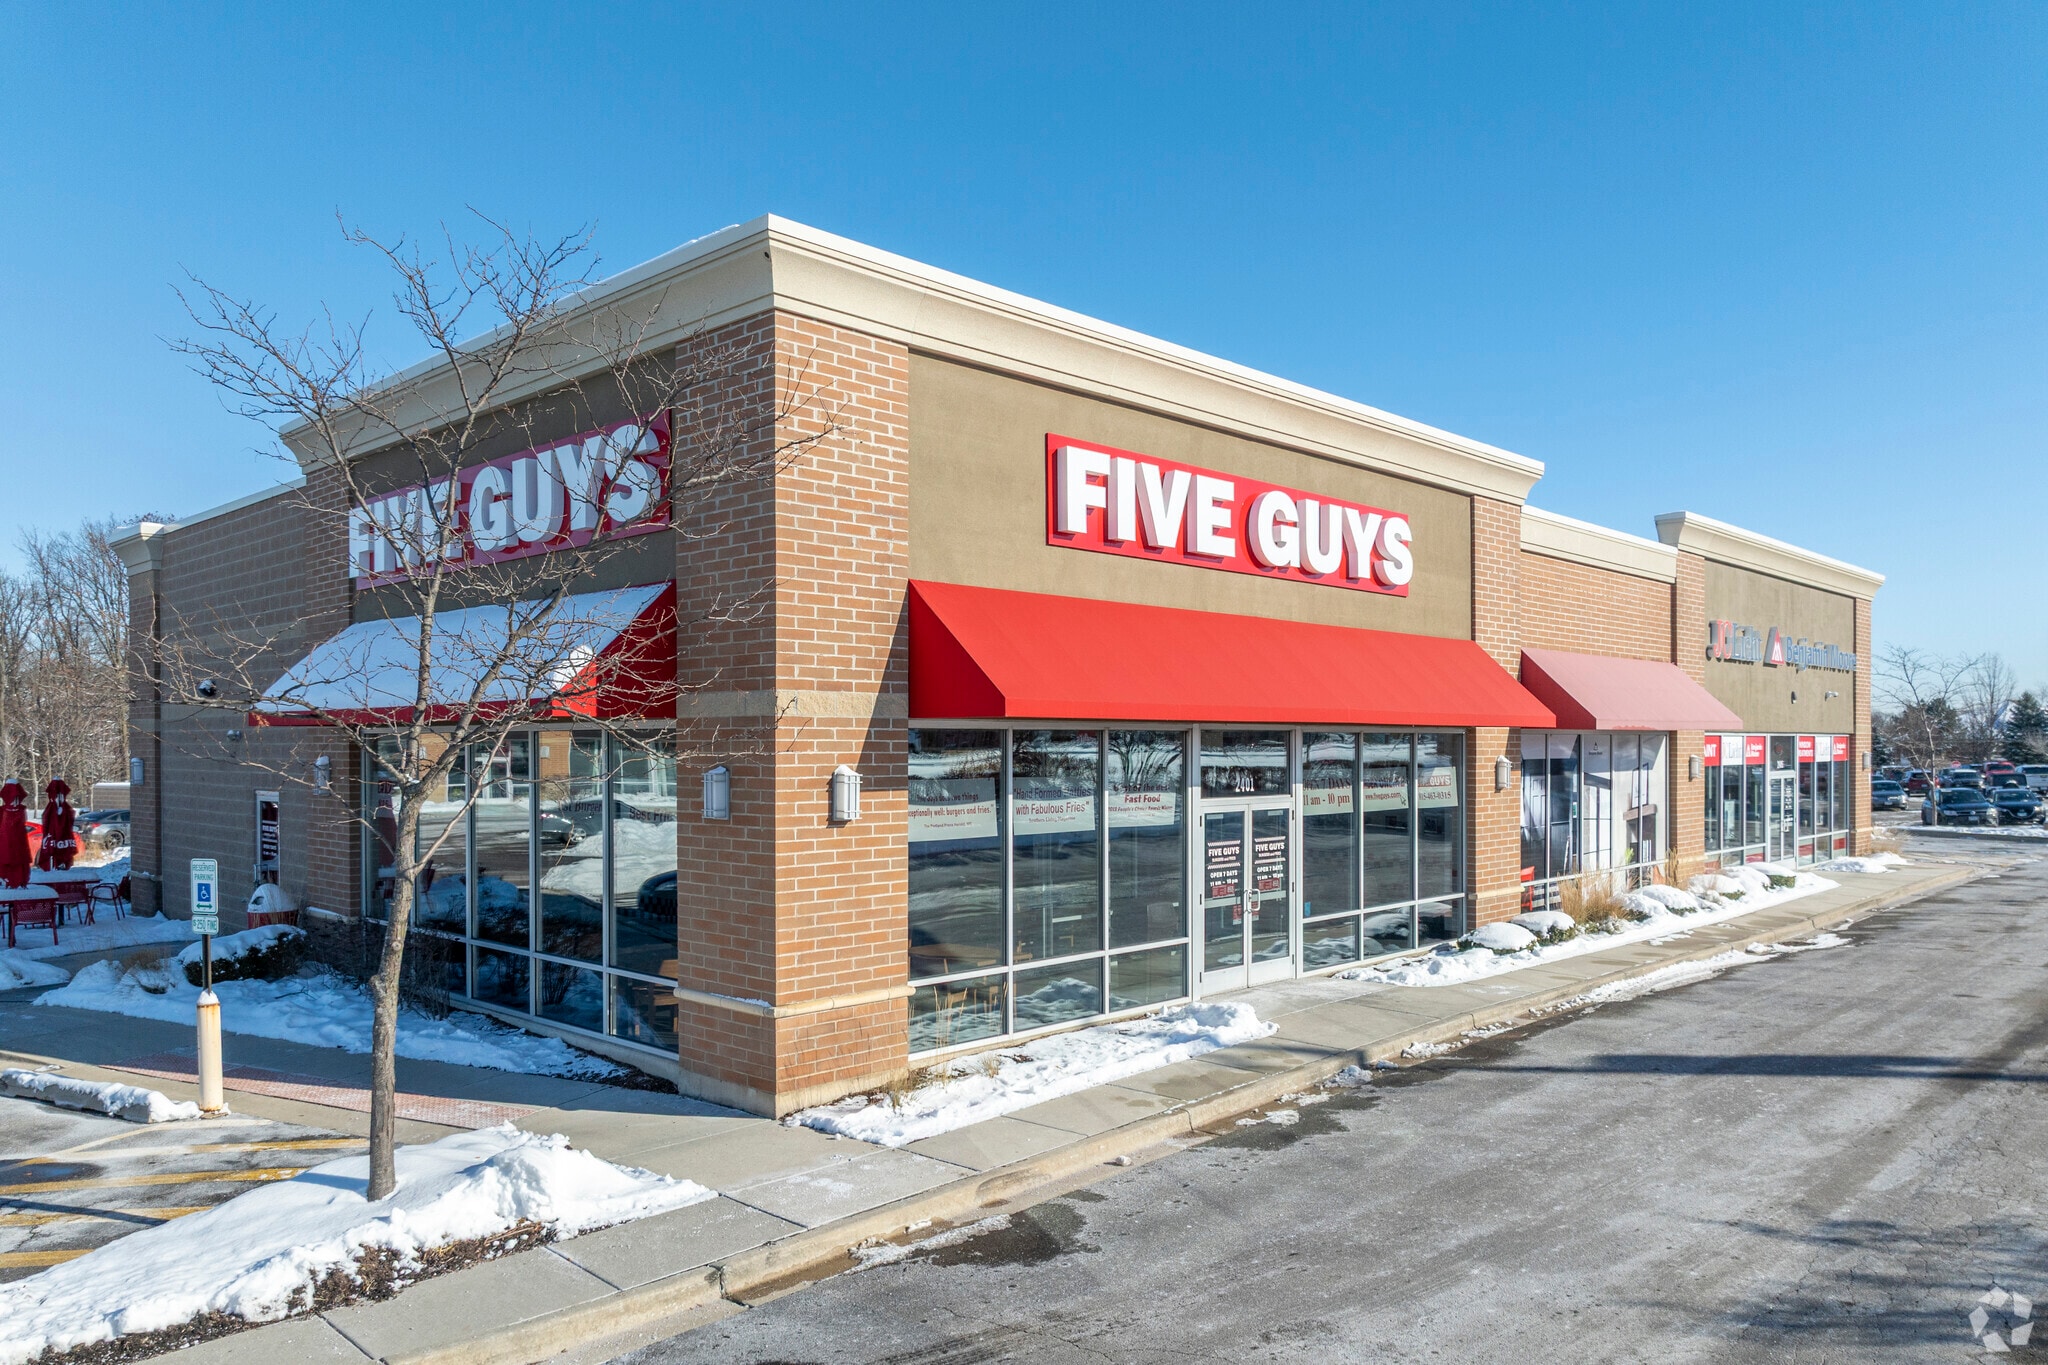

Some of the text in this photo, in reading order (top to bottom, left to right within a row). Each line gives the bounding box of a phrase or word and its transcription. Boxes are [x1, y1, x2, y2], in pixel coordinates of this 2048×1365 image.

[348, 424, 663, 578] FIVE GUYS
[1057, 445, 1413, 586] FIVE GUYS
[1786, 636, 1828, 671] Benjamin
[1236, 778, 1254, 792] 2401
[1328, 777, 1351, 789] DAYS
[1429, 776, 1452, 786] GUYS
[1034, 786, 1062, 799] Formed
[1124, 793, 1161, 804] Fast Food
[1310, 796, 1320, 806] am
[1328, 793, 1335, 804] 10
[1338, 794, 1350, 806] pm
[946, 806, 966, 817] burgers
[967, 805, 976, 814] and
[1016, 800, 1090, 816] with Fabulous Fries"
[1208, 846, 1240, 857] FIVE GUYS
[1255, 842, 1285, 852] FIVE GUYS
[192, 864, 215, 881] RESERVED PARKING
[193, 920, 217, 930] $250 FINE
